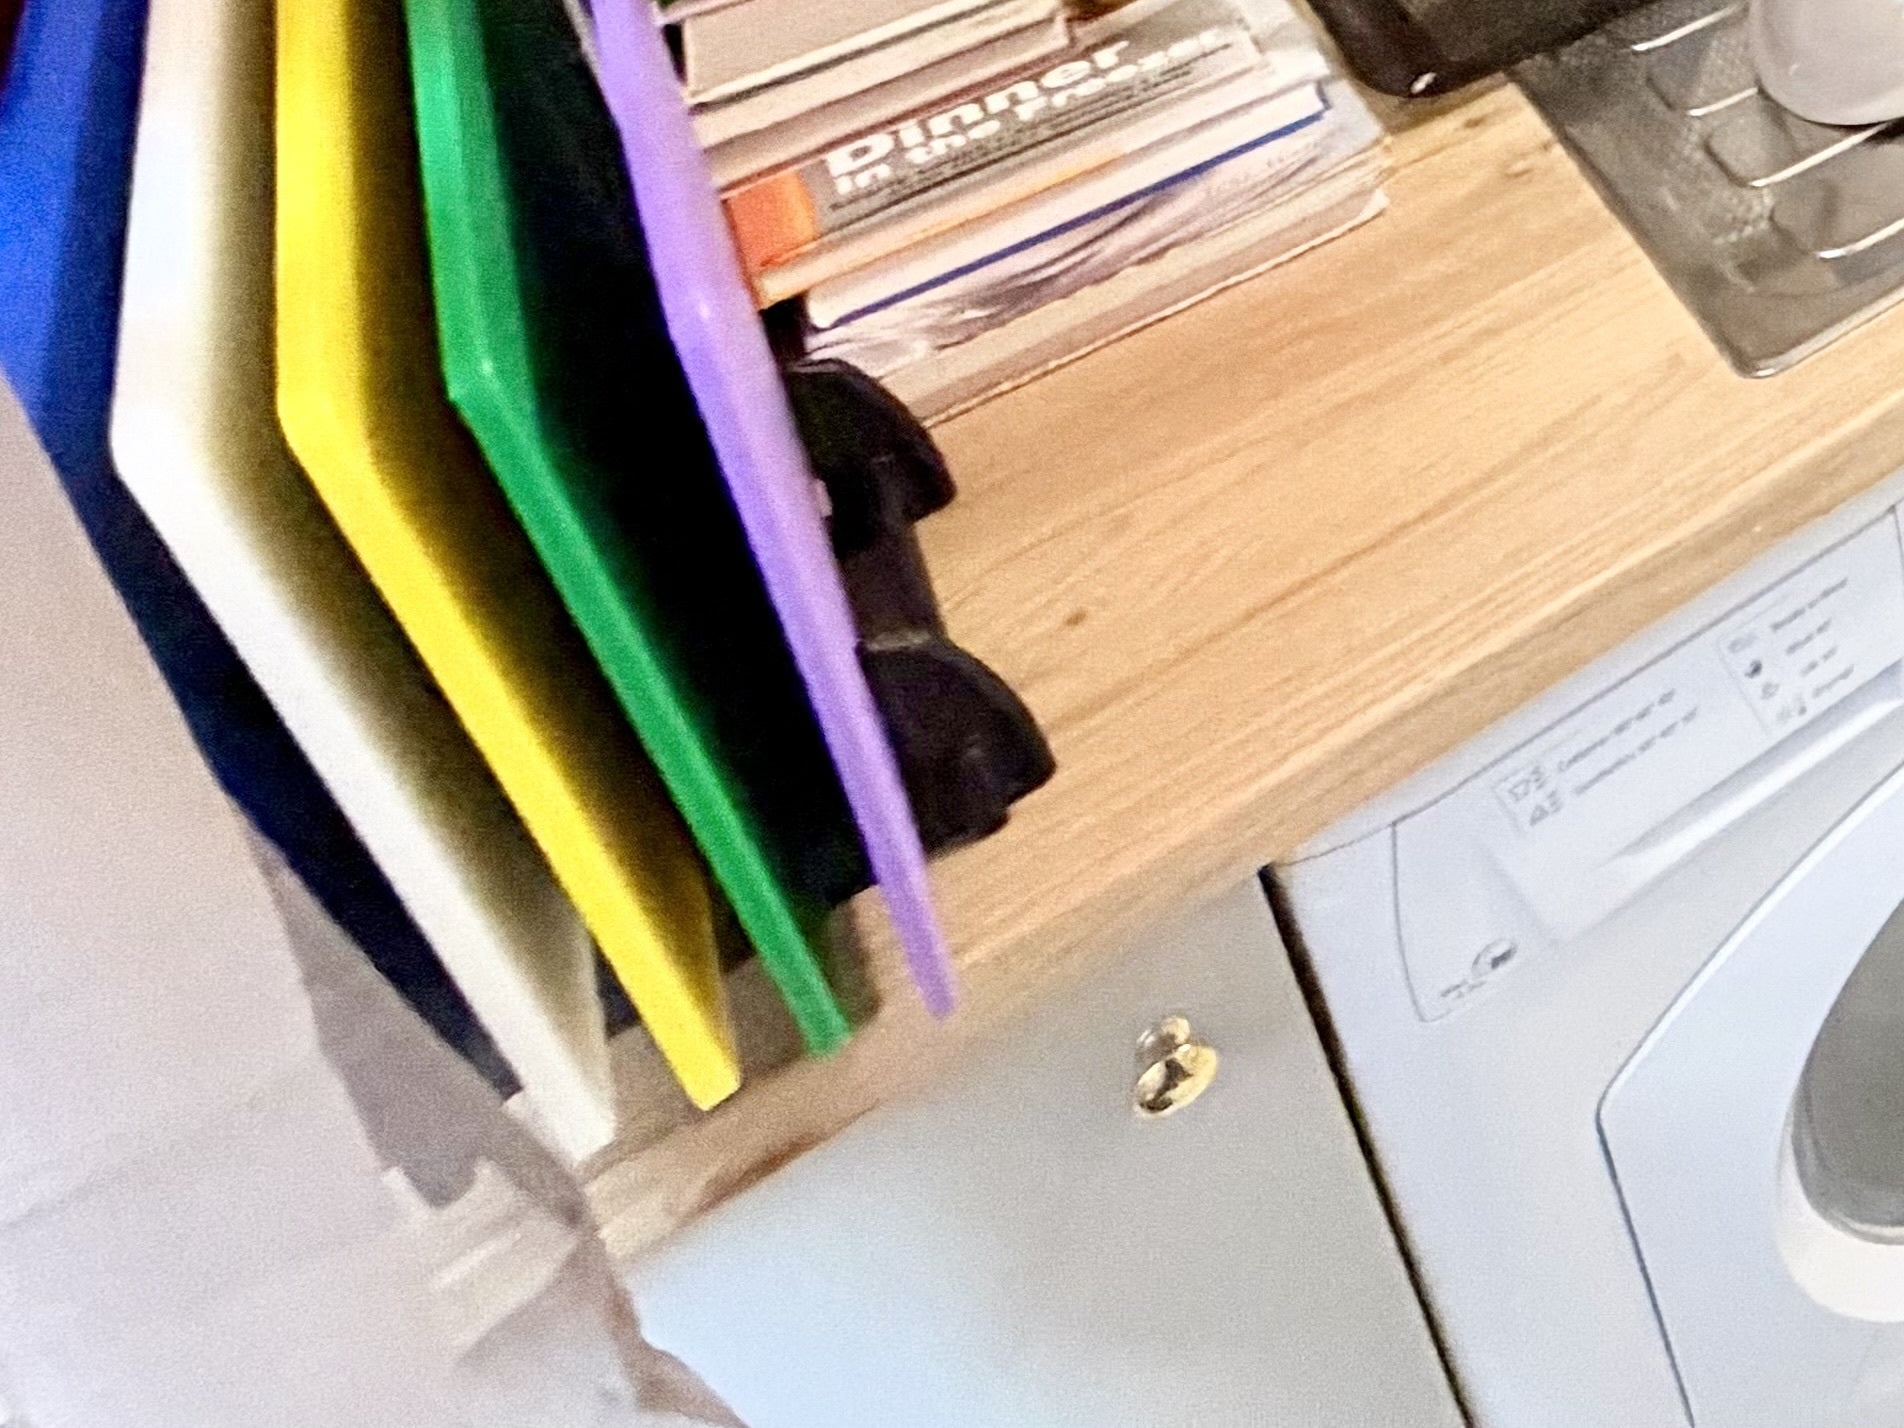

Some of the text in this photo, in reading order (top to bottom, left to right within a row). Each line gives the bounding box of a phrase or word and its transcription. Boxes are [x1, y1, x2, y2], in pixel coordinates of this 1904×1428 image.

[824, 39, 1131, 178] Dinner
[833, 163, 892, 196] in
[904, 118, 1002, 165] the
